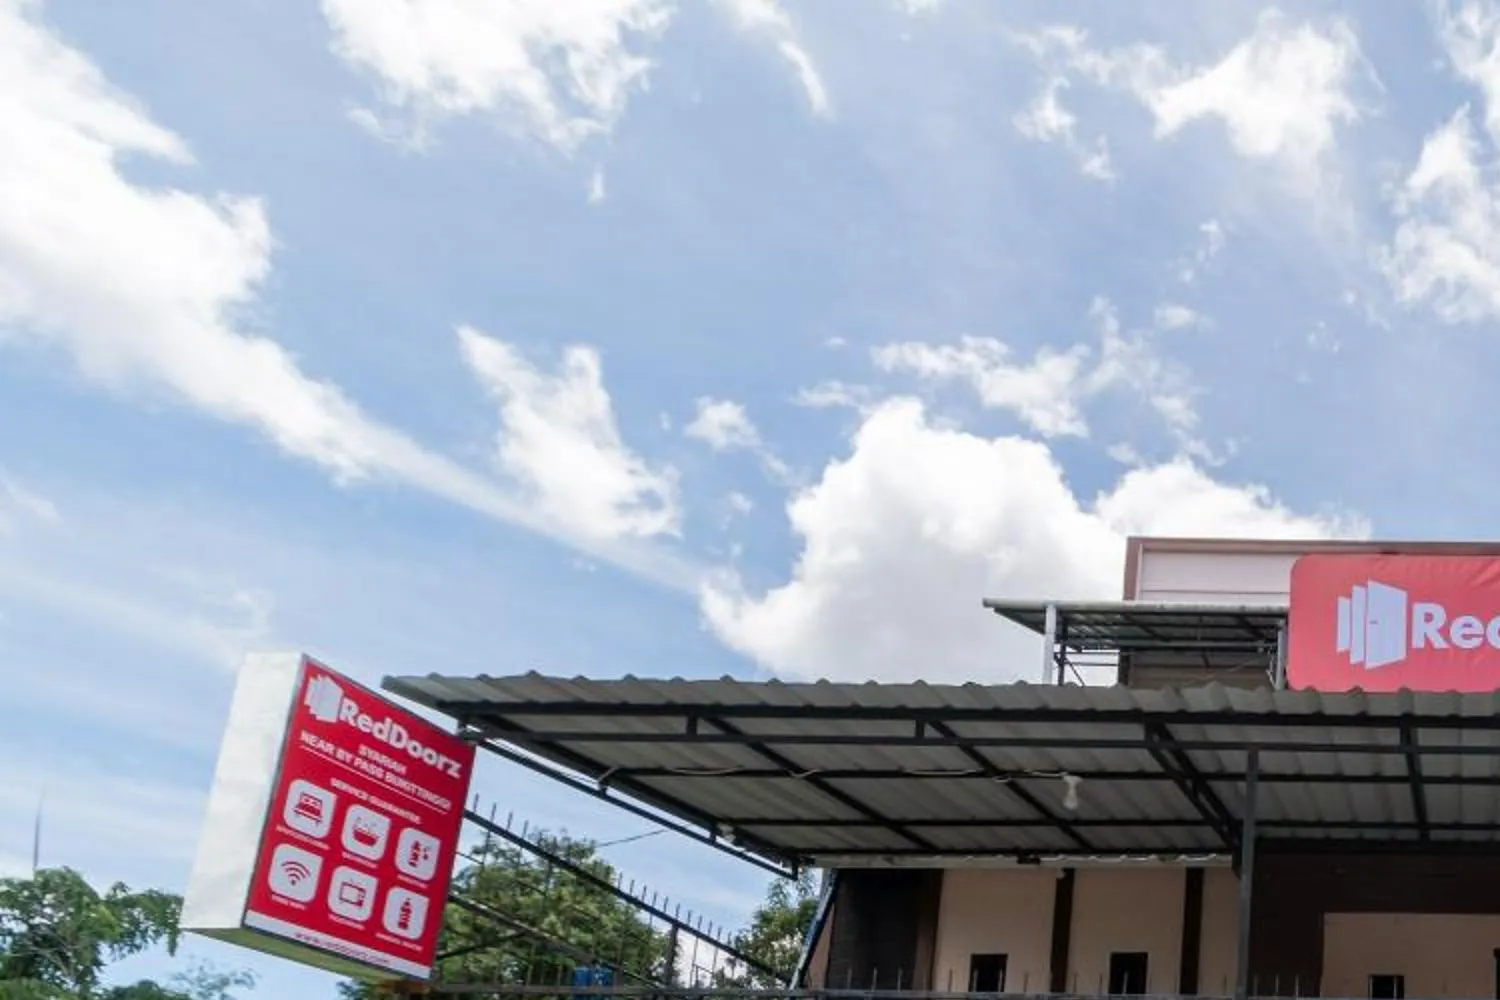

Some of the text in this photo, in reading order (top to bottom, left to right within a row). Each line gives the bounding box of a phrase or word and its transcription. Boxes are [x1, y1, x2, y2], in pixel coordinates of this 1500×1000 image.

[300, 730, 334, 755] NEAR
[335, 747, 353, 764] BY
[353, 757, 385, 779] PASS
[339, 697, 462, 780] RedDoorz
